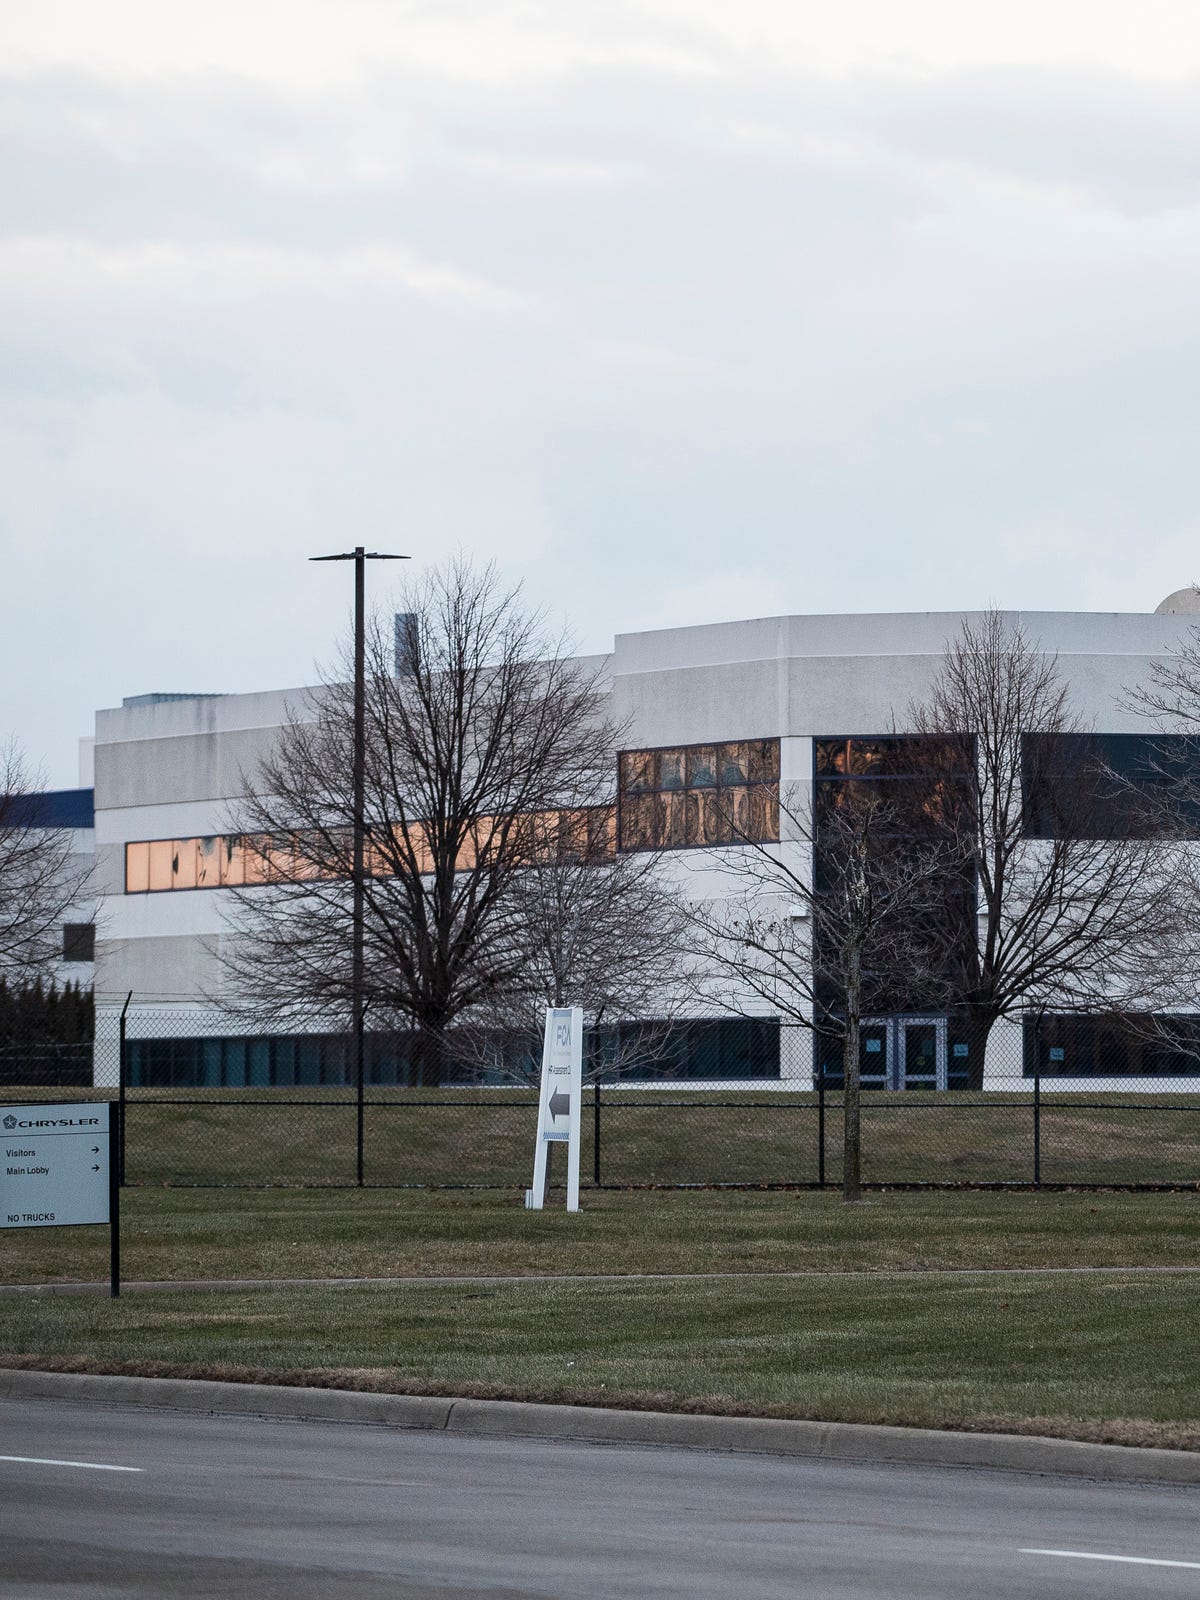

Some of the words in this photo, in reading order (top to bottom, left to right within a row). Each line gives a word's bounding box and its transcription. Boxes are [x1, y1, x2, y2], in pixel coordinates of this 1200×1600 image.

[556, 1025, 572, 1046] FCA
[18, 1118, 99, 1128] CHRYSLER
[6, 1149, 36, 1158] Visitors
[6, 1166, 26, 1176] Main
[26, 1166, 50, 1176] Lobby
[7, 1214, 20, 1223] NO
[22, 1212, 56, 1222] TRUCKS
